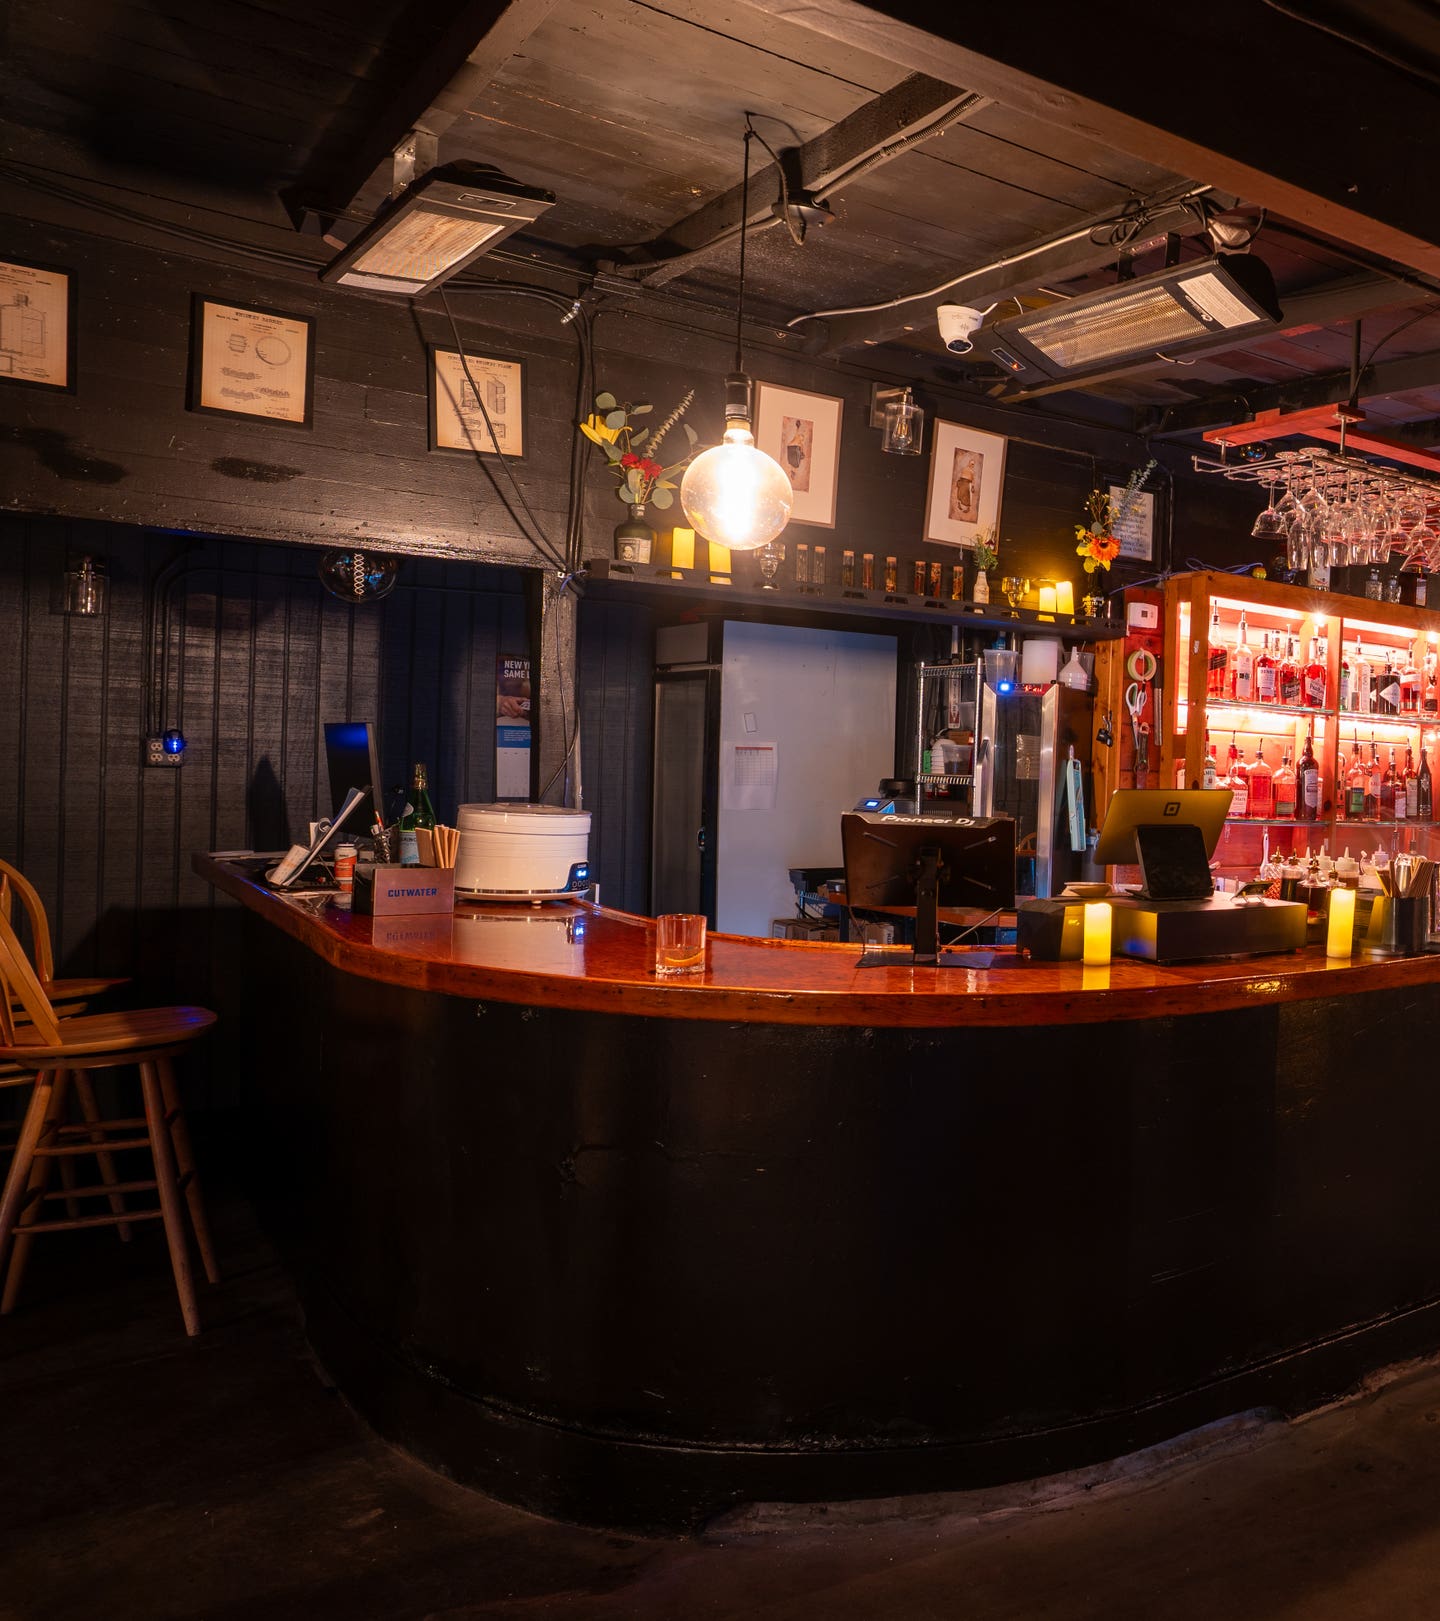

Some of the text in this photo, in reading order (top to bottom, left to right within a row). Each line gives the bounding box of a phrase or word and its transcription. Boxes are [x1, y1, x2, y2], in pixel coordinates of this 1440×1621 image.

[504, 660, 521, 669] NEW
[504, 670, 525, 678] SAME
[881, 815, 953, 824] Pioneer
[387, 888, 438, 898] CUTWATER
